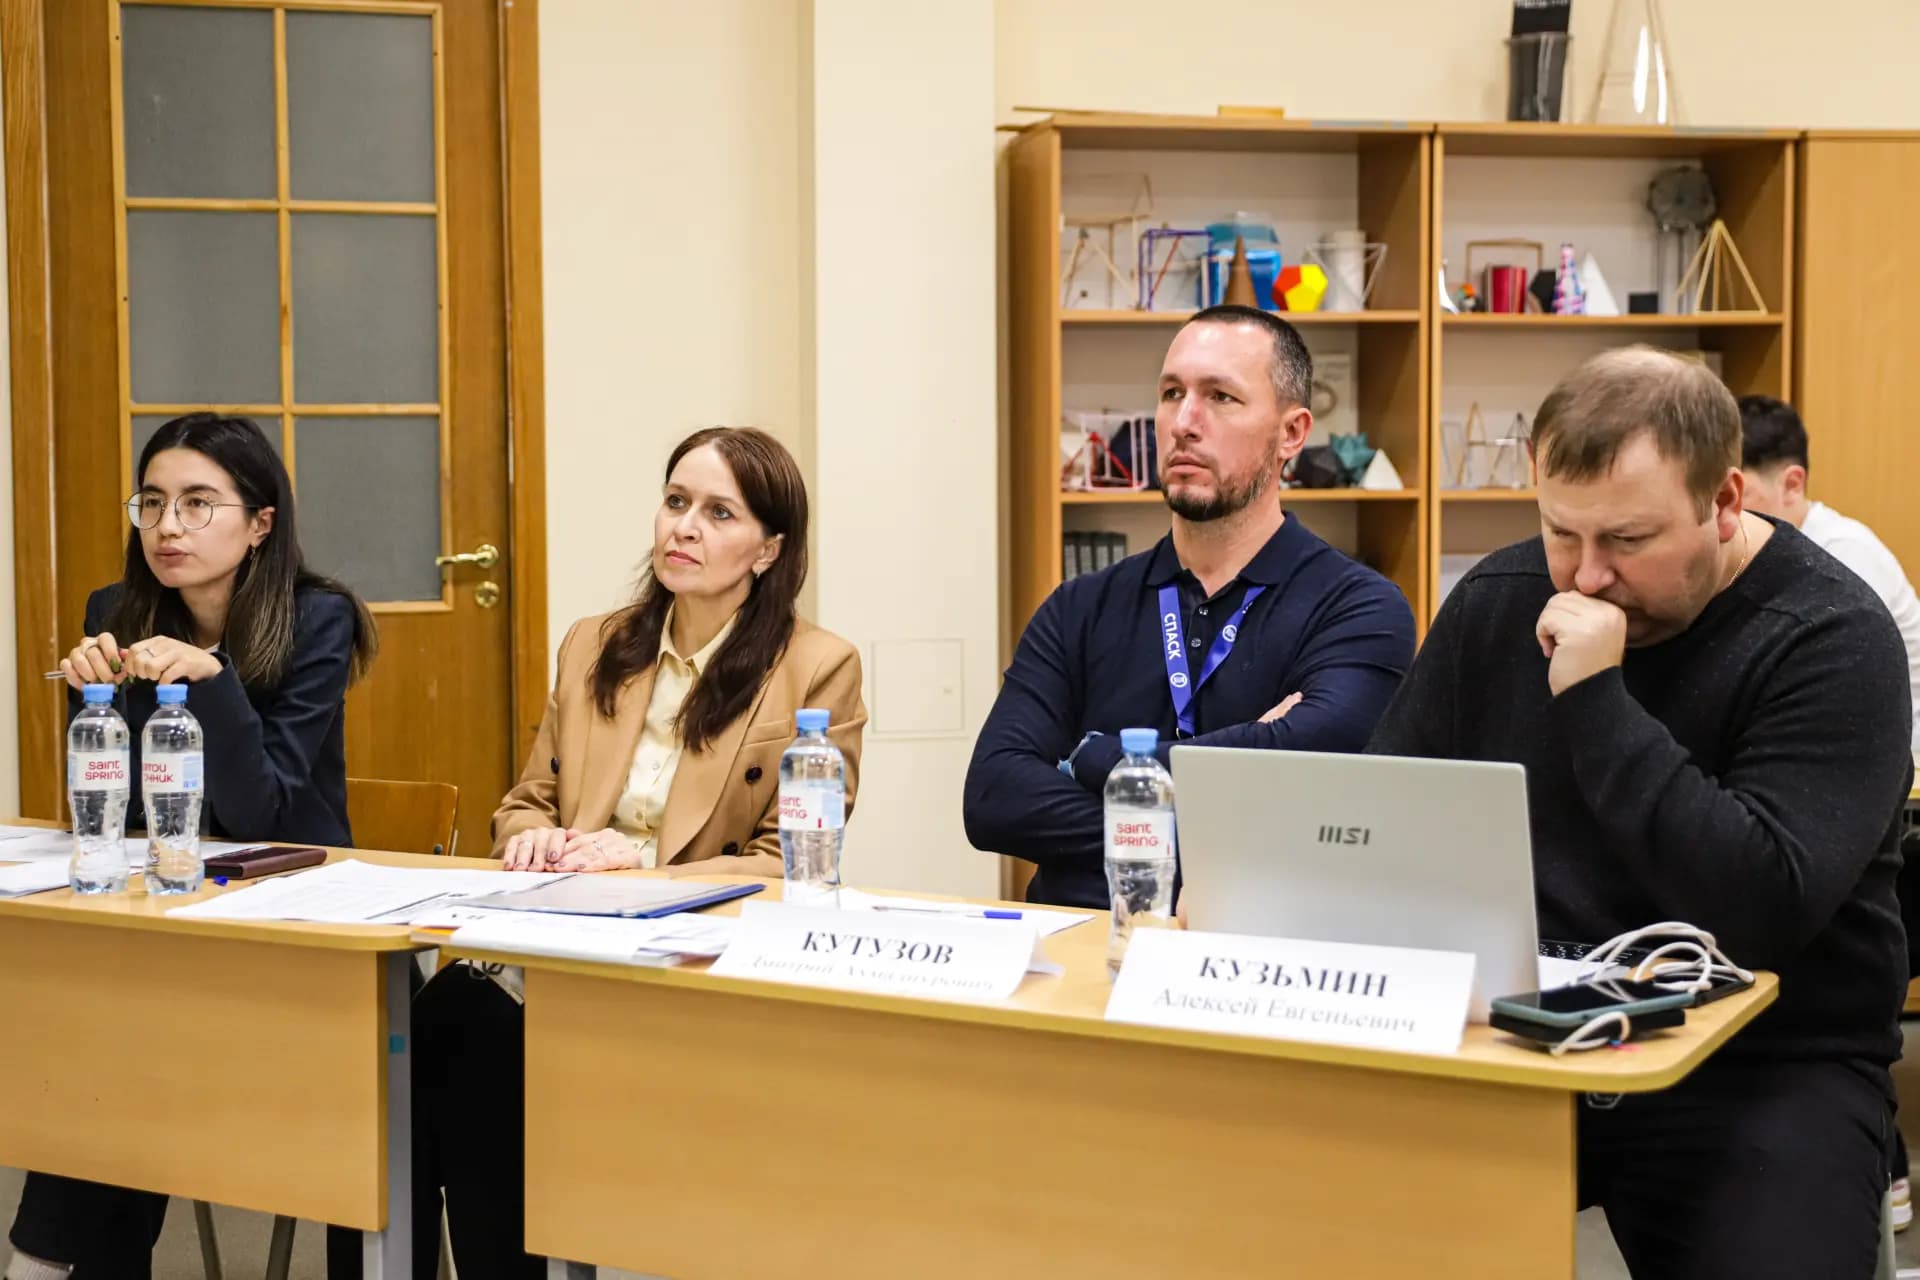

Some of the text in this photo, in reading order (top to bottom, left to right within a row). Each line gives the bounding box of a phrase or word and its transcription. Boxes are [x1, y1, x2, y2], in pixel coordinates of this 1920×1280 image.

[1164, 612, 1182, 660] СПАСК
[801, 930, 954, 965] КУТУЗОВ
[1198, 956, 1391, 998] КУЗЬМИН
[1153, 987, 1417, 1034] Алексей Евгеньевич
